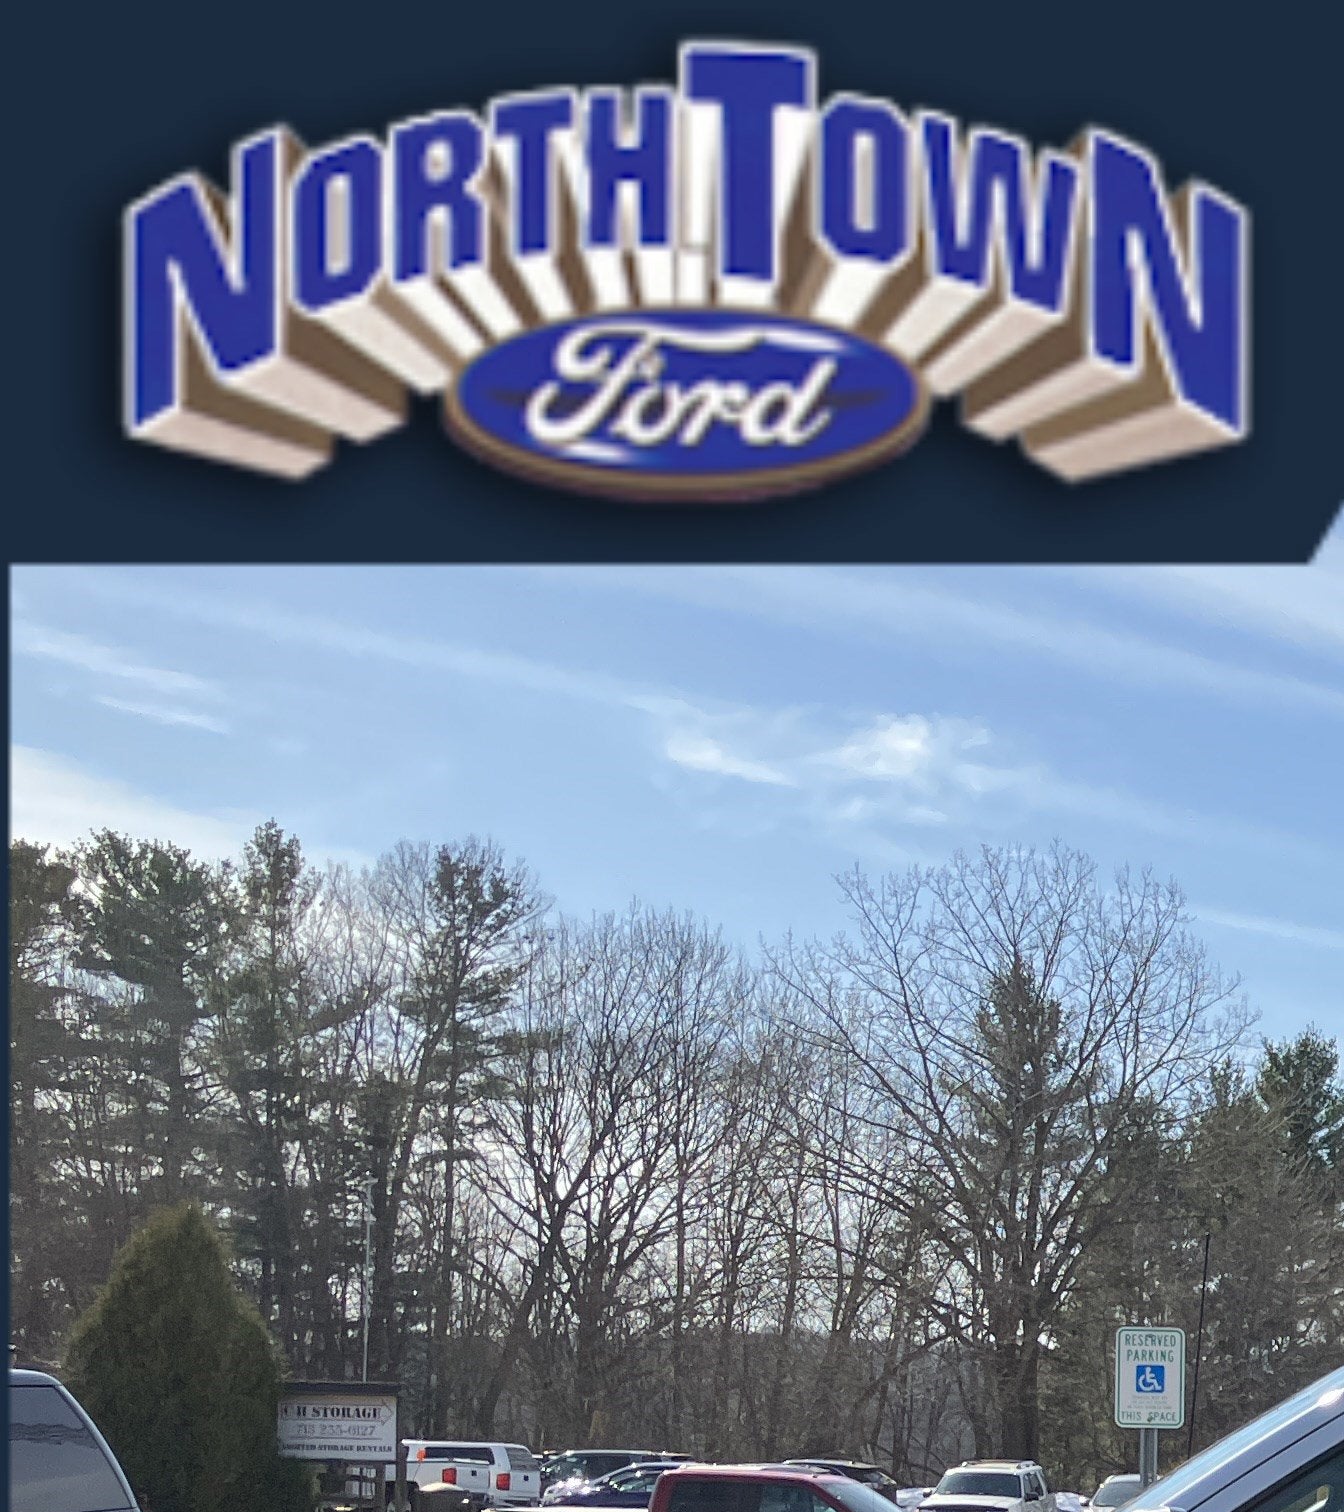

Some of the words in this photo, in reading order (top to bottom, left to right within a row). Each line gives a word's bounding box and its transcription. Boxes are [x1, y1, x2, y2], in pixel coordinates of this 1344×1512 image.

[1124, 1333, 1177, 1347] RESERVED
[1126, 1349, 1175, 1362] PARKING
[311, 1406, 382, 1419] STORAGE
[1121, 1411, 1142, 1421] THIS
[1147, 1411, 1177, 1422] SPACE
